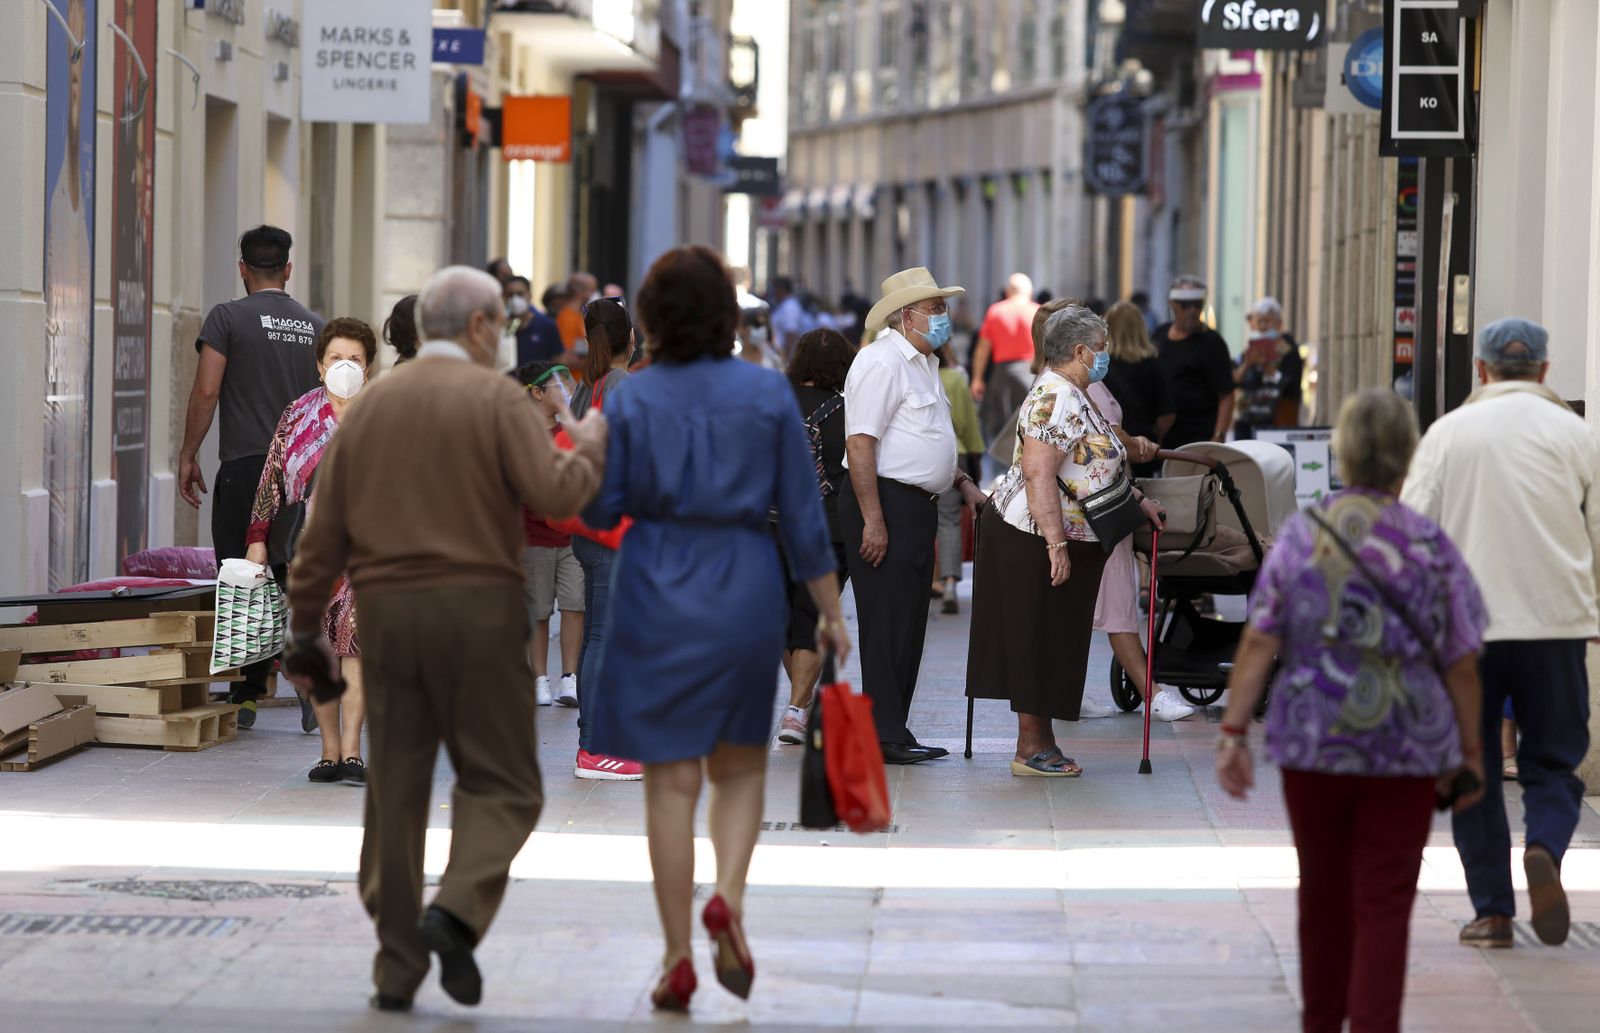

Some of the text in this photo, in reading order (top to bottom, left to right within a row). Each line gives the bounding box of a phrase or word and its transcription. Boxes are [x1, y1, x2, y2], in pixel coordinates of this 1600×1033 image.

[1222, 1, 1300, 31] Sfera
[320, 26, 393, 46] MARKS
[398, 29, 411, 46] &
[1421, 32, 1438, 43] SA
[316, 50, 416, 70] SPENCER
[333, 78, 398, 91] LINGERIE
[1419, 97, 1438, 108] KO
[503, 144, 563, 160] orange
[271, 317, 315, 331] MAGOSA
[267, 331, 281, 341] 957
[298, 335, 313, 345] 879
